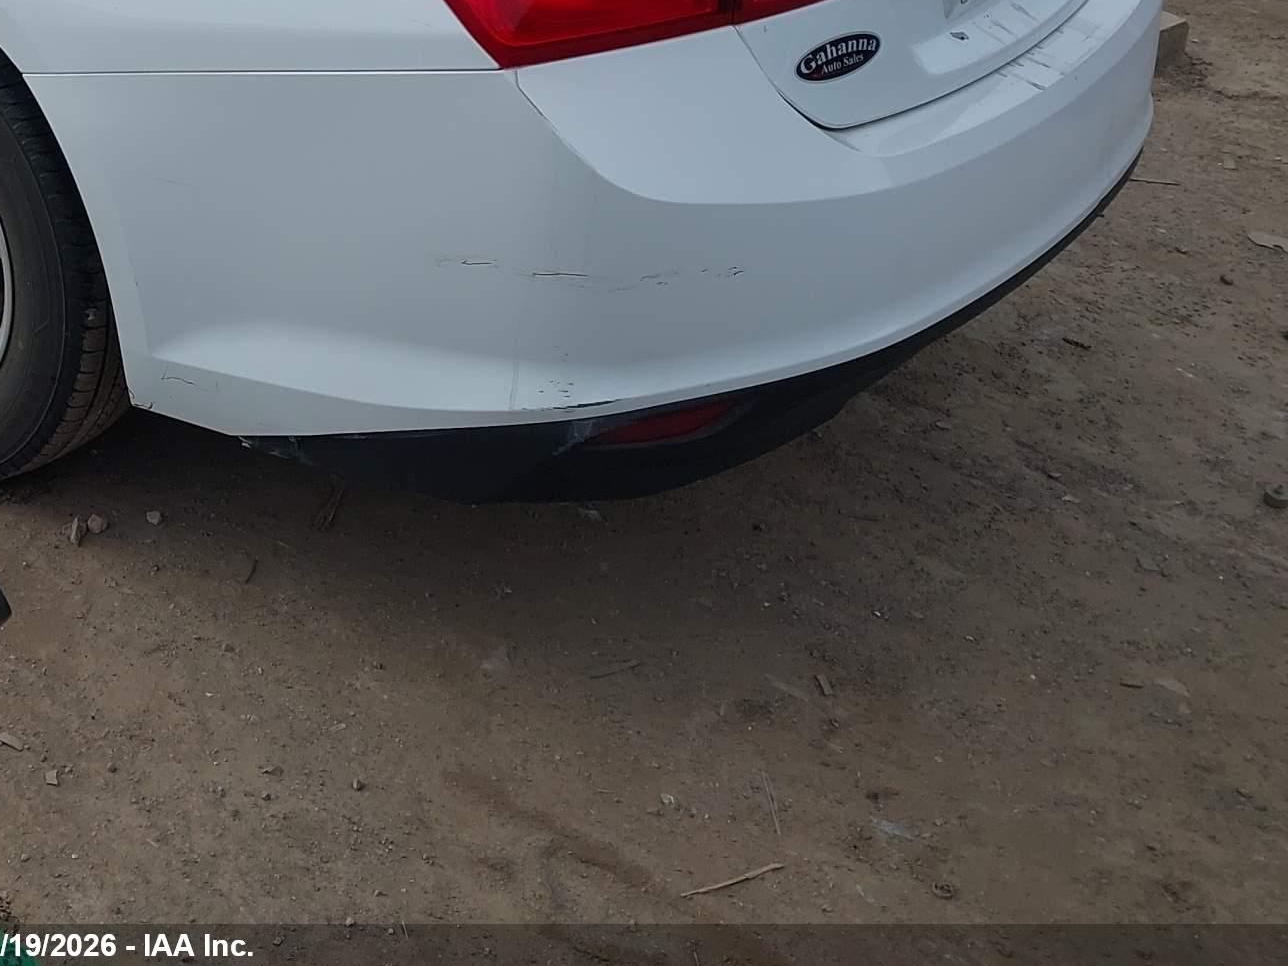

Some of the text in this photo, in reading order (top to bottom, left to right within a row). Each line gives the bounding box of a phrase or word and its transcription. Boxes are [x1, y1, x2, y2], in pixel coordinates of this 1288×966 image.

[800, 38, 877, 74] Gahanna
[821, 53, 864, 74] Auto Sales
